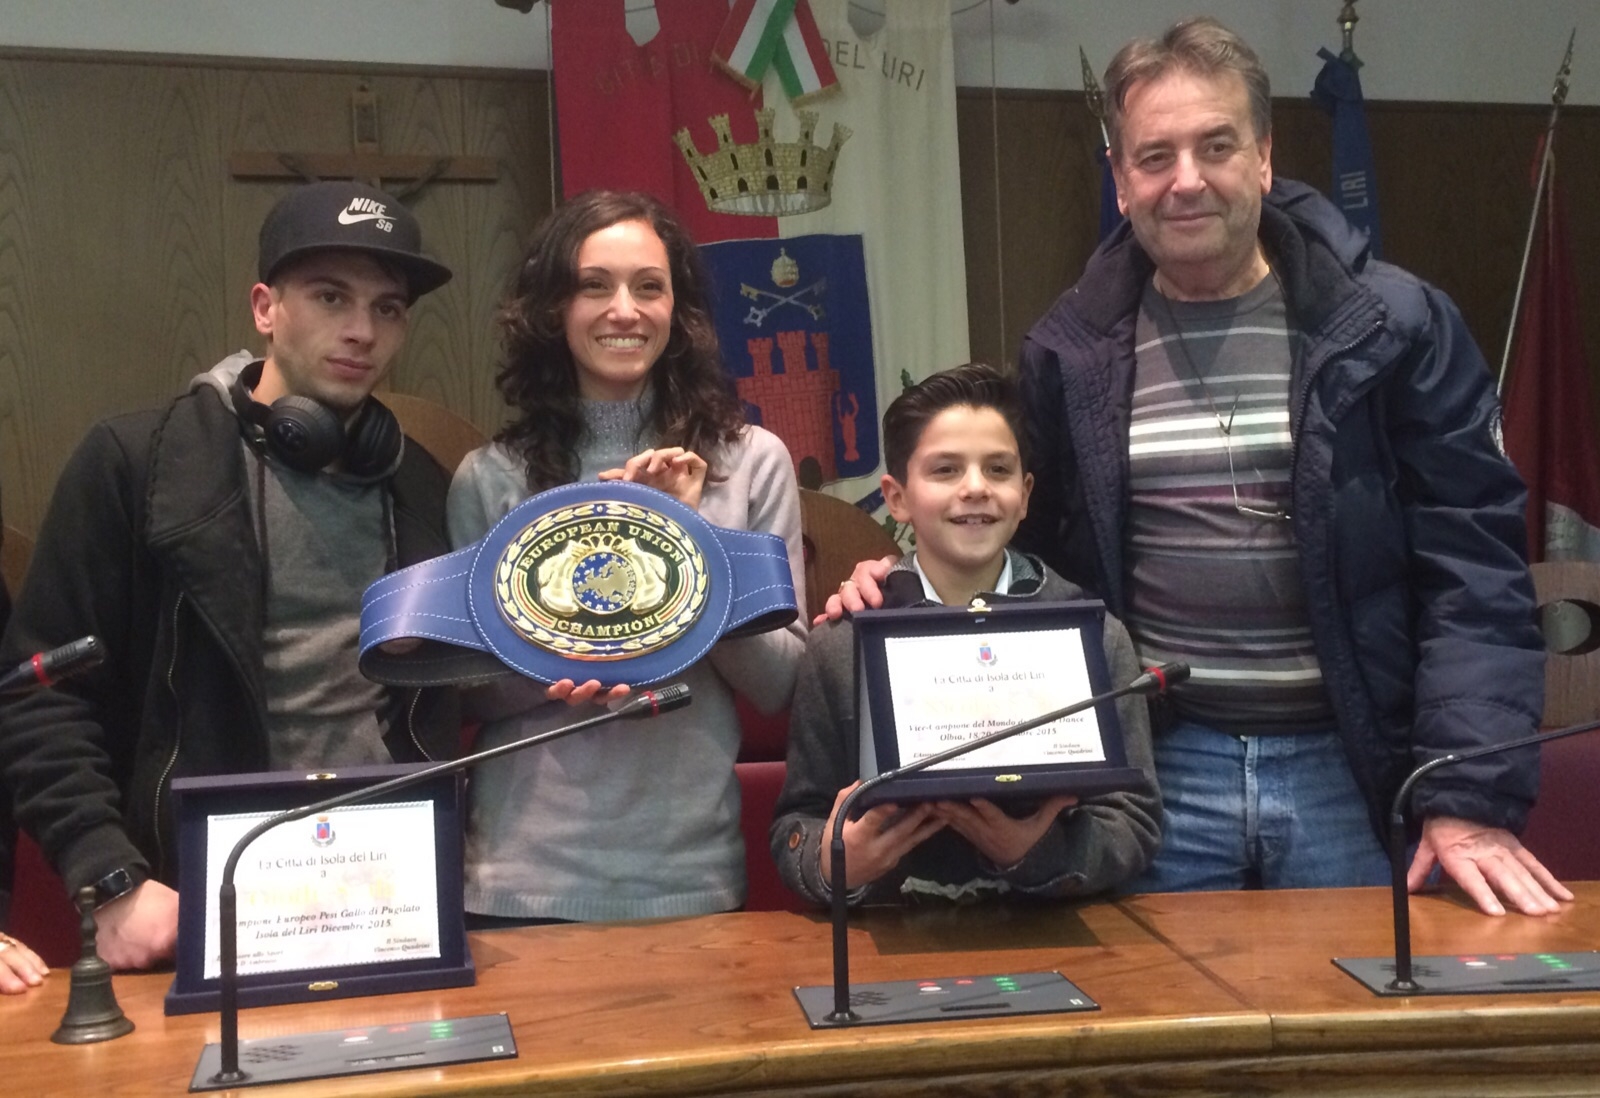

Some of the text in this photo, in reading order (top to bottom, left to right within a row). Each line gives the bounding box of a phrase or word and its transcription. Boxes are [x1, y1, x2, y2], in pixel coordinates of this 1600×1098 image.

[881, 50, 925, 91] LIRI
[1340, 171, 1368, 211] LIRI
[348, 197, 387, 216] NIKE
[375, 218, 394, 233] SB
[520, 521, 685, 569] EUROPEAN UNION
[556, 616, 655, 637] CHAMPION
[986, 672, 1009, 682] Isola
[1011, 671, 1027, 681] del
[972, 719, 985, 728] del
[987, 718, 1016, 727] Mondo
[1036, 727, 1057, 736] 2015
[305, 856, 317, 867] di
[319, 853, 346, 866] Isola
[348, 851, 367, 864] del
[369, 850, 388, 862] Liri
[276, 910, 317, 923] Europeo
[319, 910, 338, 921] Pesi
[369, 906, 379, 917] di
[381, 904, 421, 916] Pugilato
[255, 919, 392, 940] Isola del Liri Dicembre 2015
